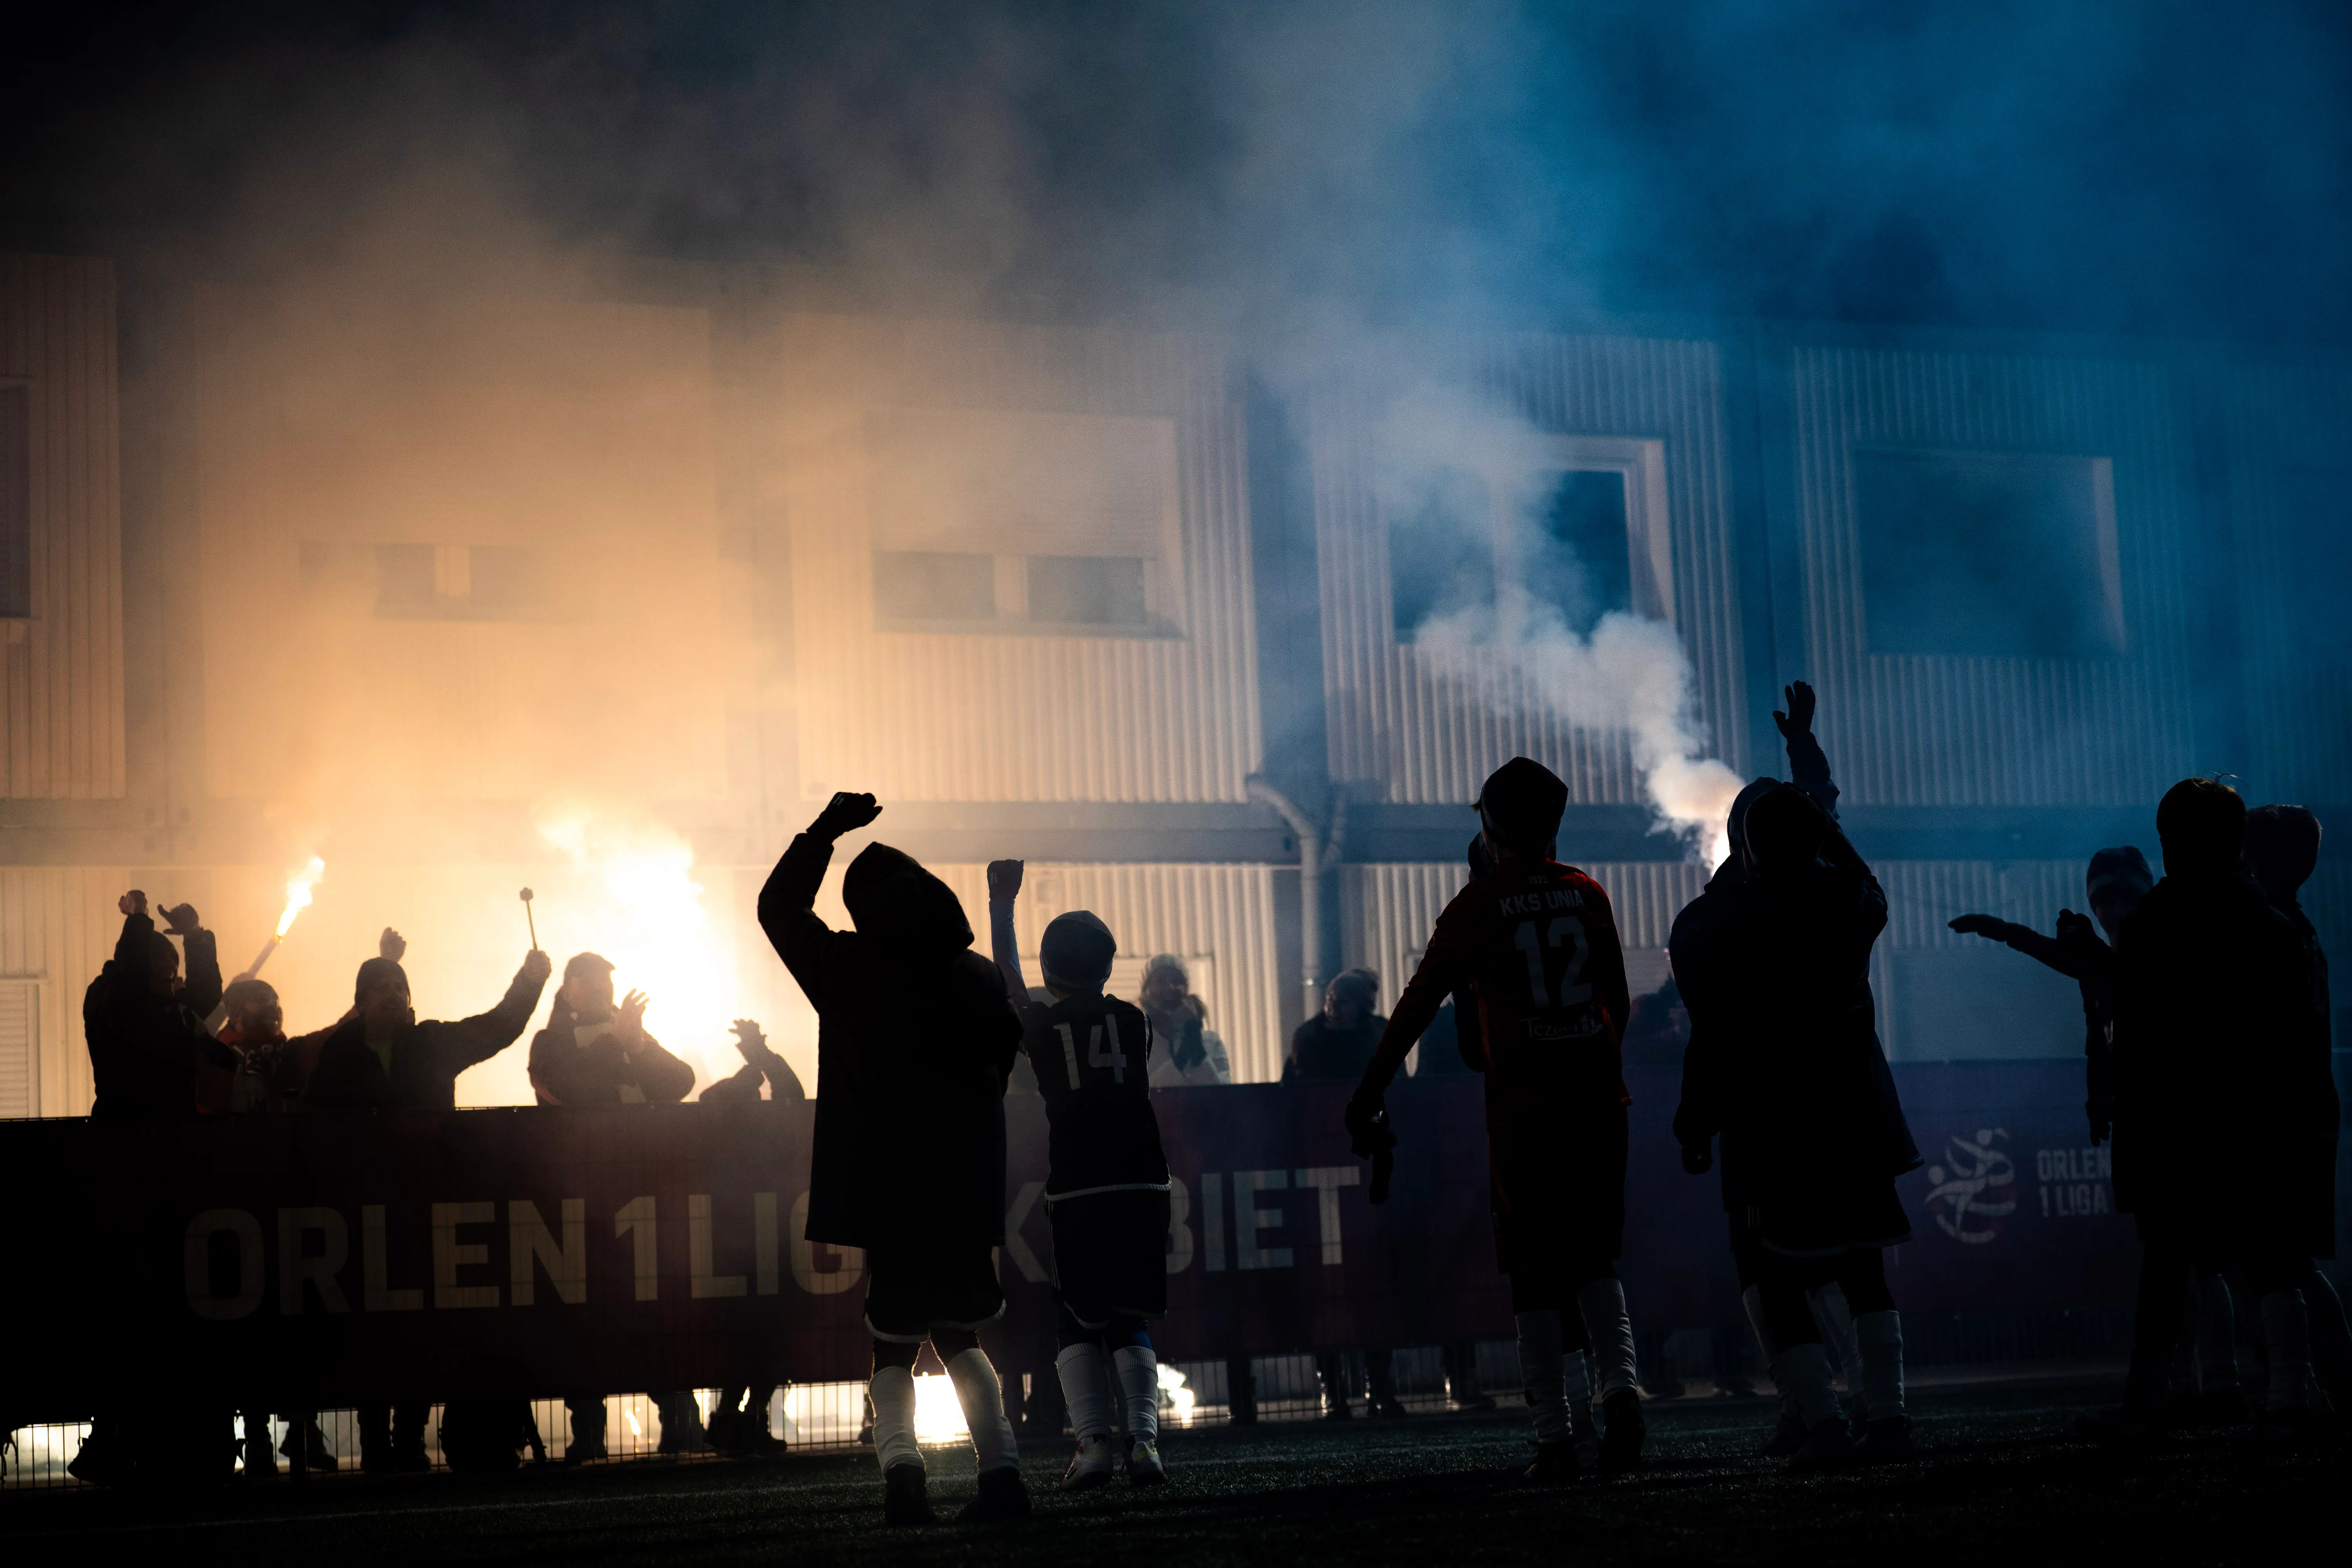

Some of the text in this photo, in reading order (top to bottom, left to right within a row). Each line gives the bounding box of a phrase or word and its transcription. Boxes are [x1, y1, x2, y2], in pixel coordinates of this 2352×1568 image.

[1499, 889, 1585, 916] KKS UNIA
[1514, 915, 1592, 1009] 12
[1053, 1013, 1127, 1091] 14
[2036, 1148, 2112, 1181] ORLEN
[2038, 1183, 2109, 1218] 1 LIGA
[183, 1165, 1361, 1321] ORLEN 1 LIG KIET
